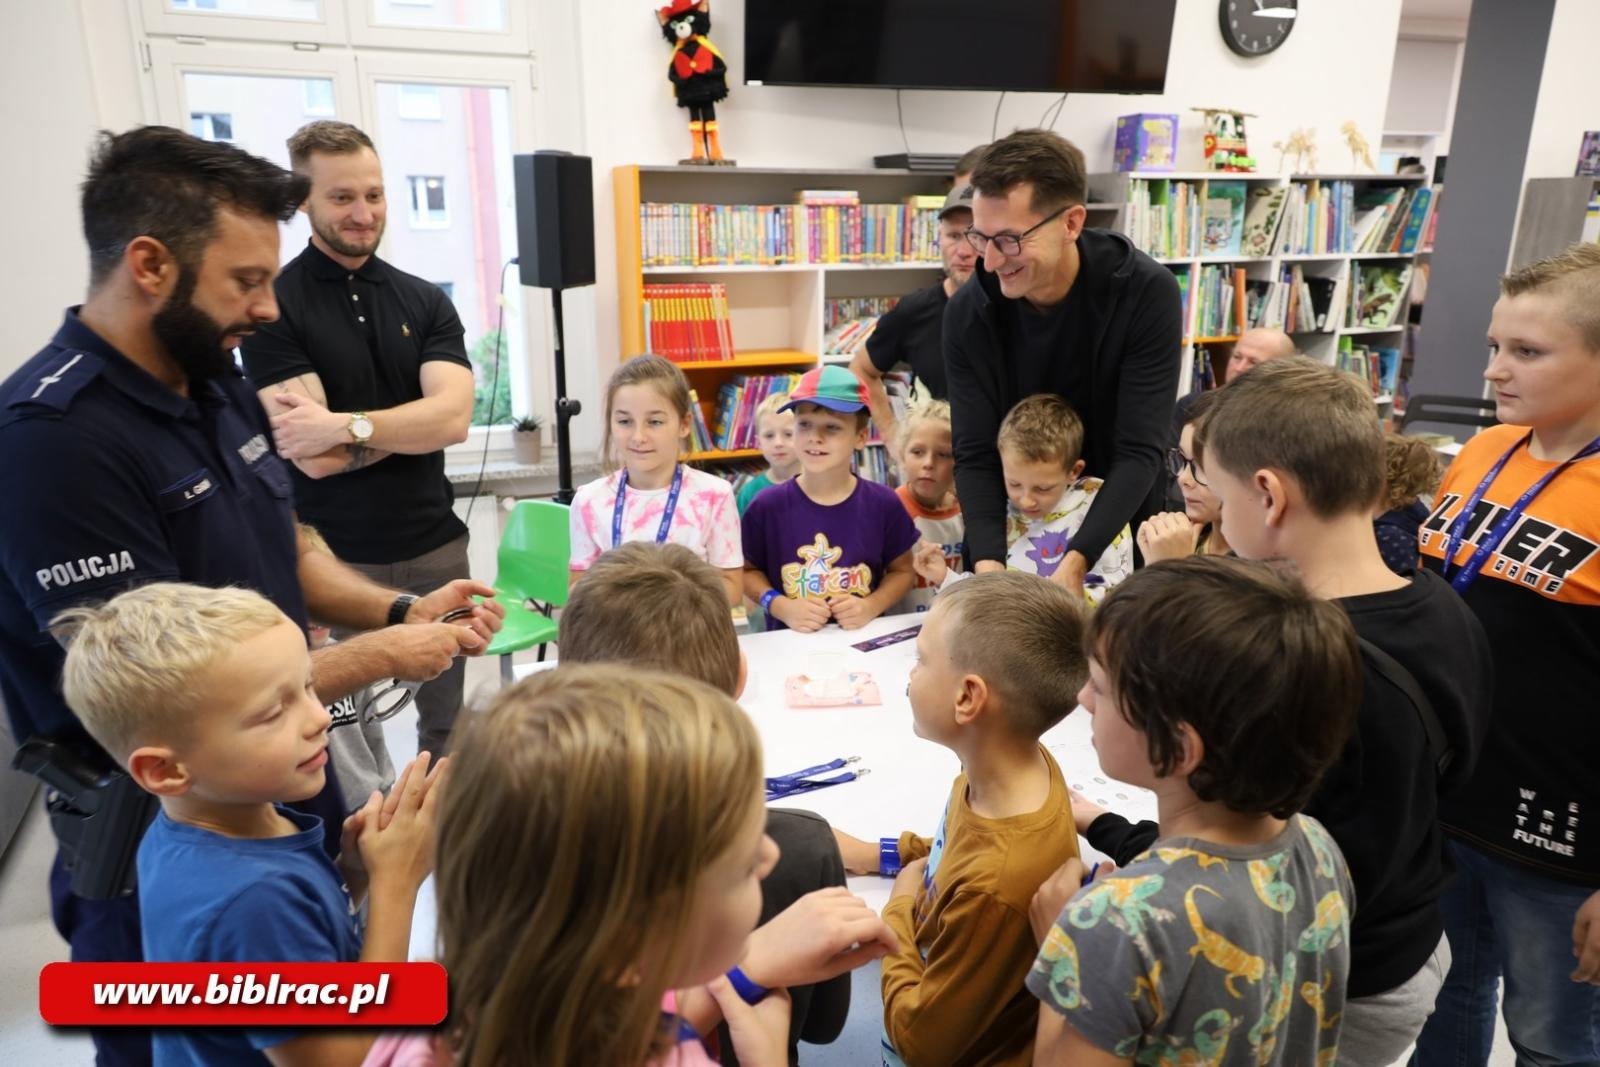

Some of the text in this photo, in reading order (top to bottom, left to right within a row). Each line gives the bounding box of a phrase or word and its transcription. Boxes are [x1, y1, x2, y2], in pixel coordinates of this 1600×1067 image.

[36, 550, 136, 591] POLICJA
[1493, 555, 1563, 595] GAME
[1512, 828, 1576, 857] FUTURE
